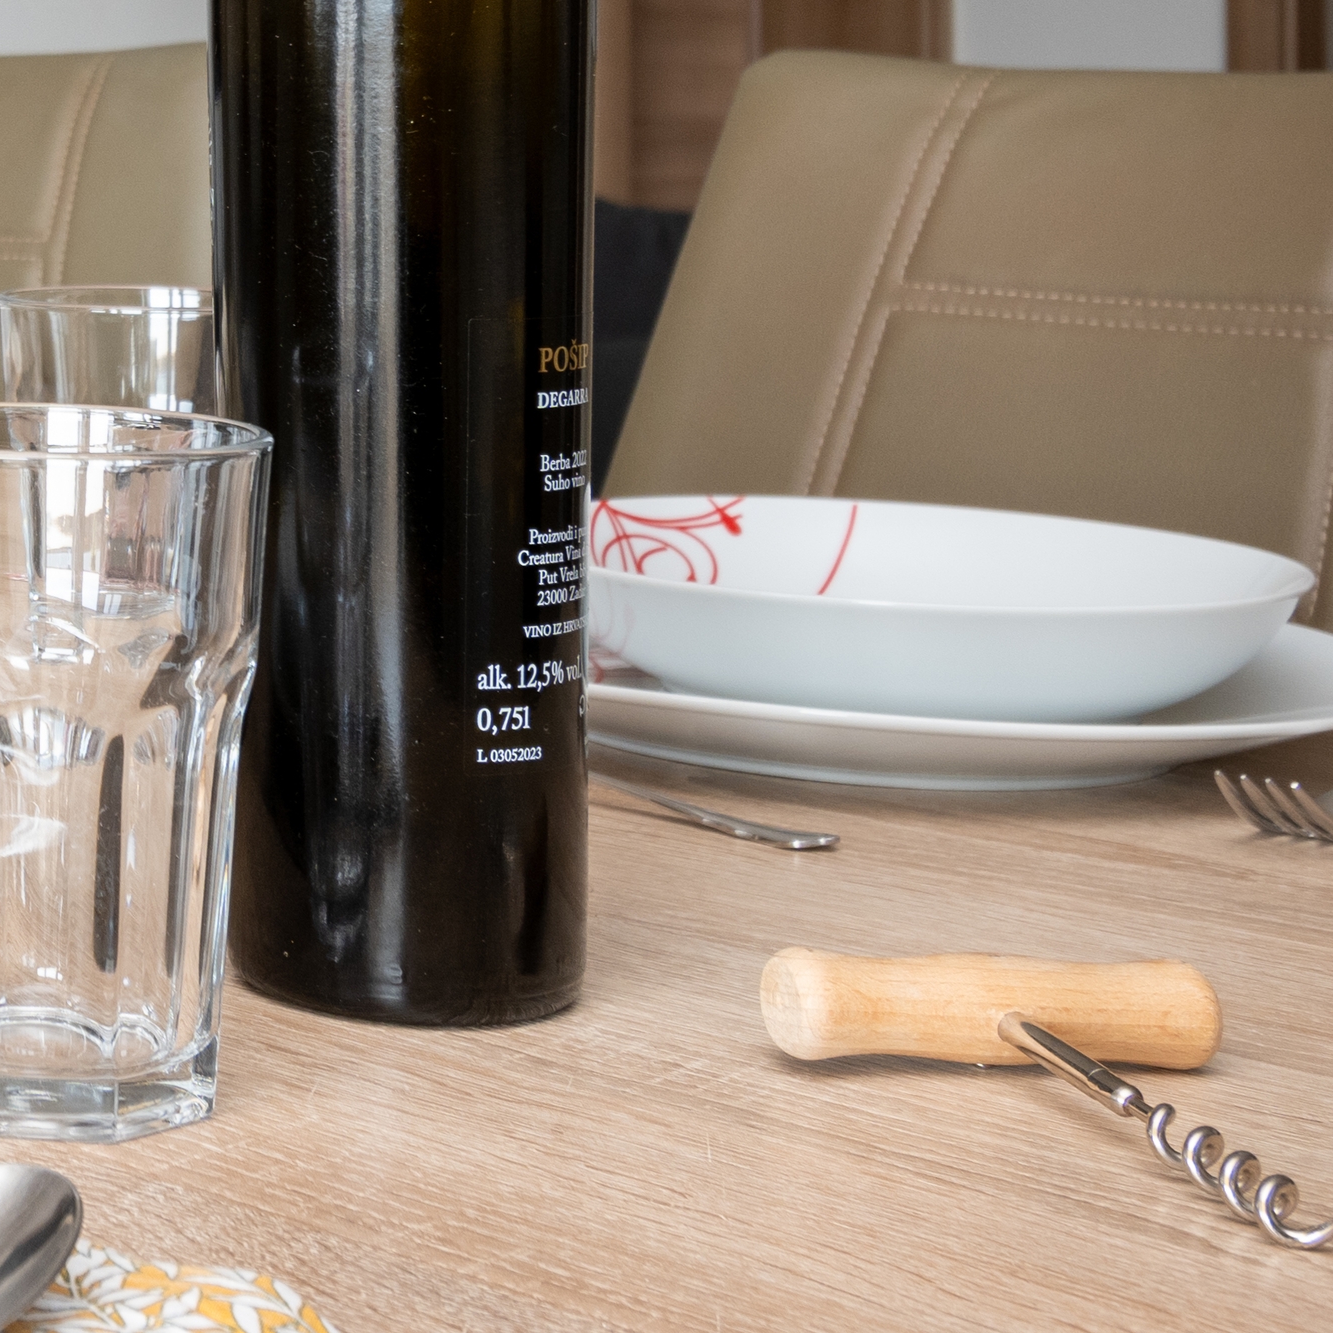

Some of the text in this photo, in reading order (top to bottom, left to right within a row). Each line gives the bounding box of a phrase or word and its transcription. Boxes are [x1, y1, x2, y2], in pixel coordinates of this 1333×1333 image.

[537, 338, 589, 374] POŠIP
[539, 453, 571, 472] Berba
[544, 473, 571, 492] Suho
[528, 524, 574, 545] Proizvodi
[517, 549, 564, 567] Creatura
[538, 569, 558, 586] Put
[559, 564, 579, 582] Vrela
[536, 588, 568, 606] 23000
[523, 624, 552, 638] VINO
[552, 621, 563, 635] IZ
[477, 664, 512, 690] alk.
[517, 660, 564, 692] 12,5%
[476, 746, 542, 763] L 03052023
